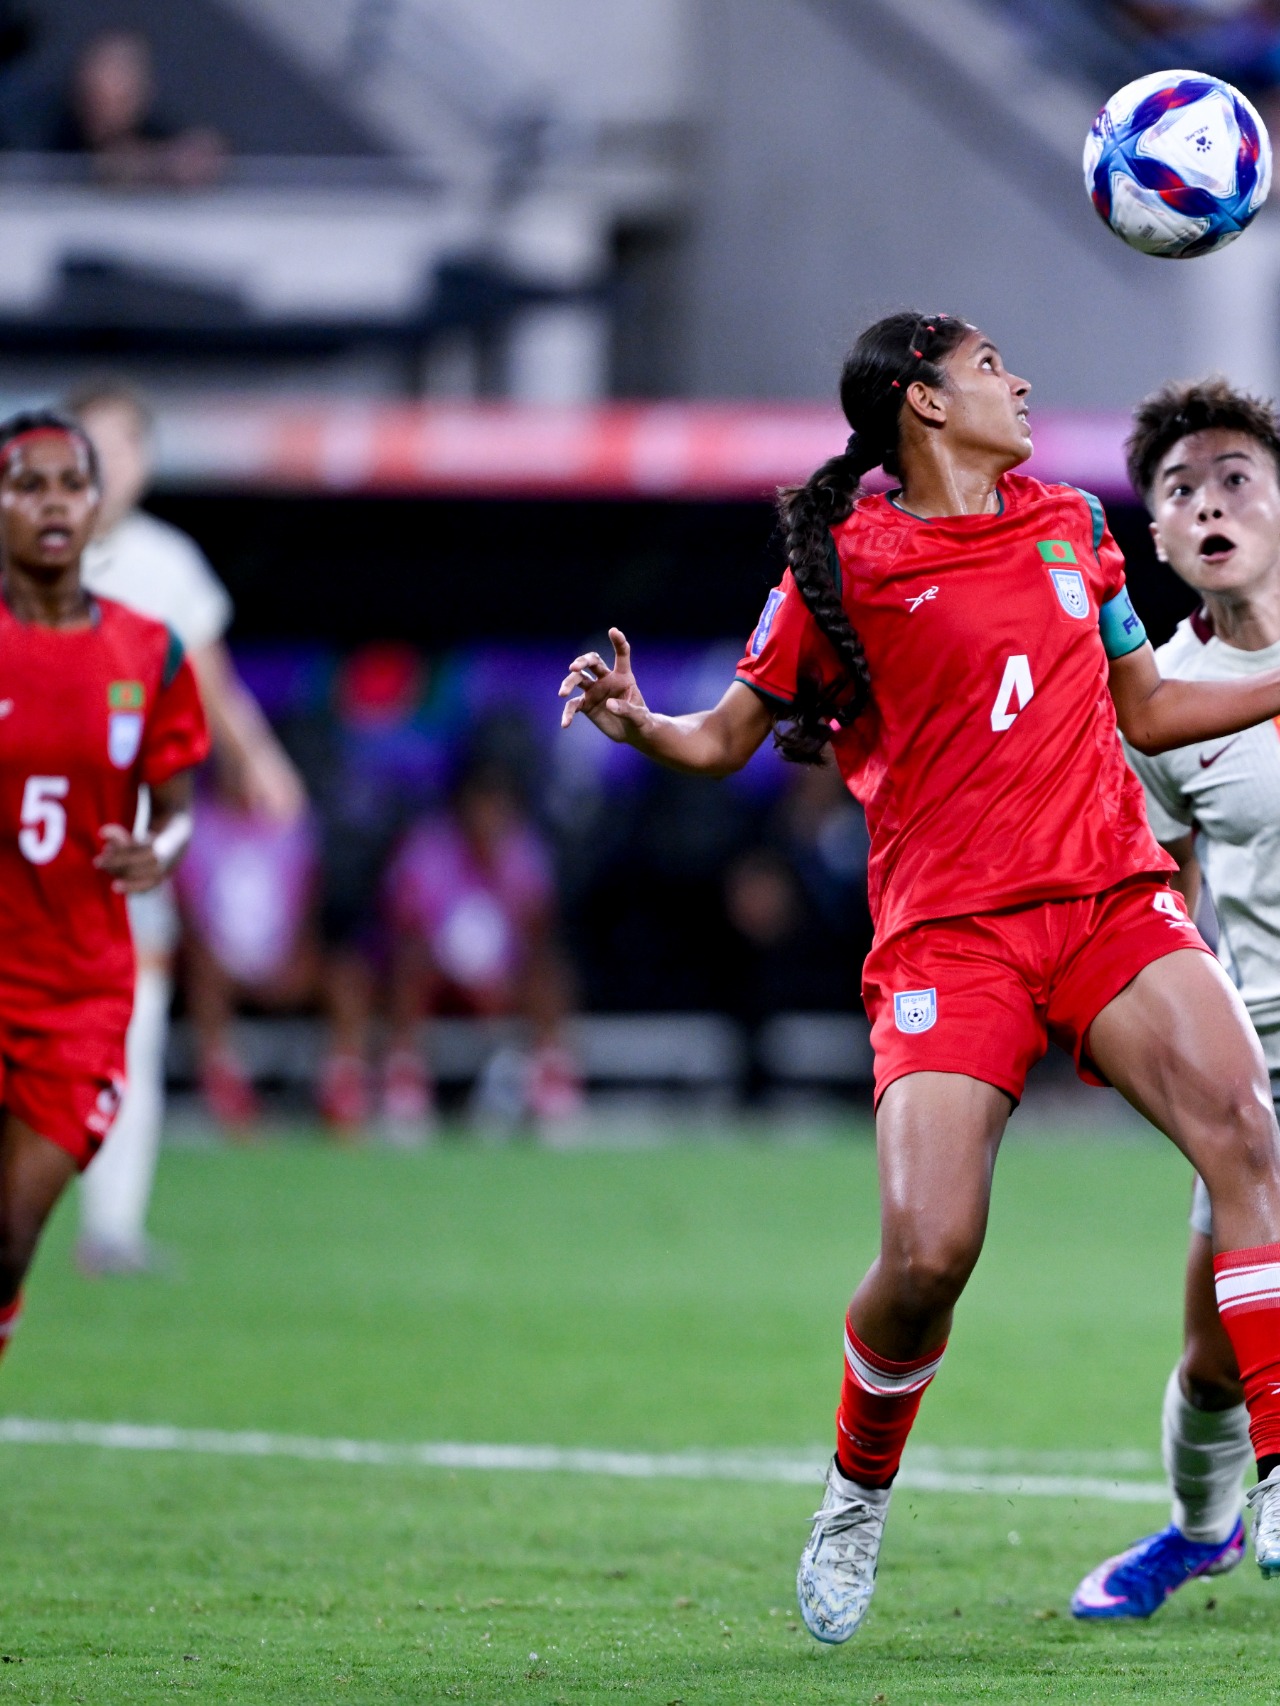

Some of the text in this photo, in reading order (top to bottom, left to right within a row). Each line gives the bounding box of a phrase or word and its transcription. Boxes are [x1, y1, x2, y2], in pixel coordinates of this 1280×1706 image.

[990, 654, 1034, 732] 4
[18, 775, 69, 866] 5
[1153, 891, 1185, 920] 4
